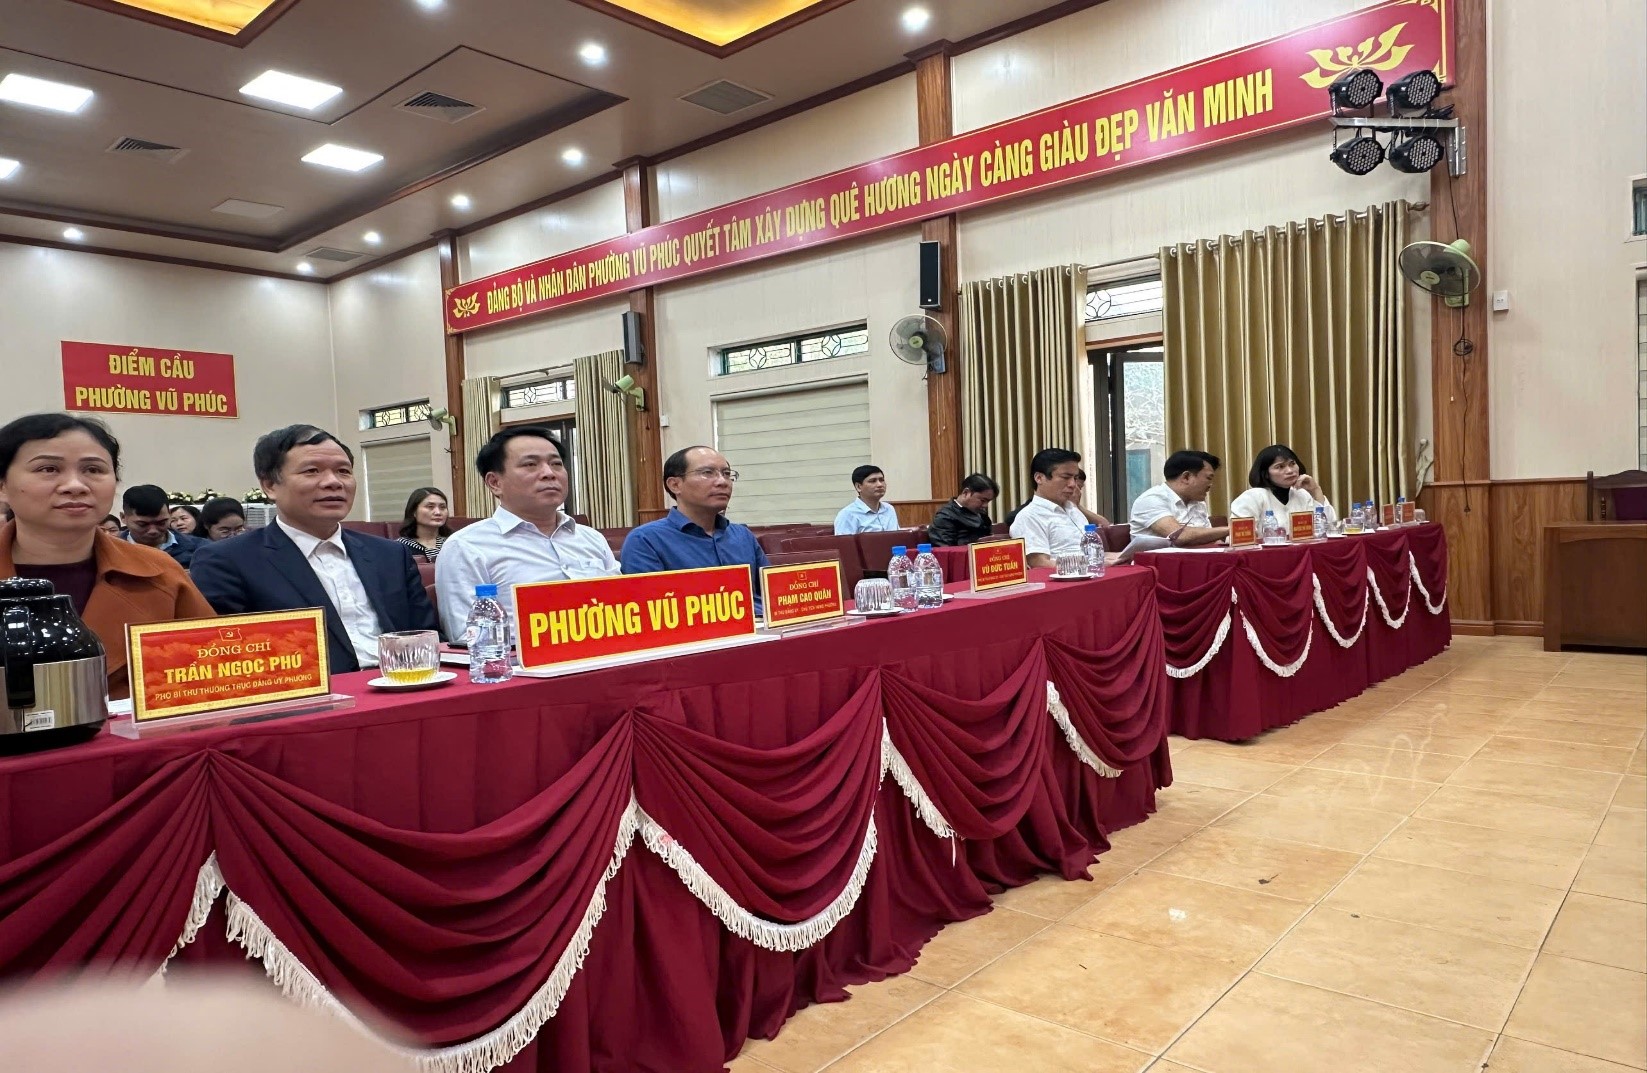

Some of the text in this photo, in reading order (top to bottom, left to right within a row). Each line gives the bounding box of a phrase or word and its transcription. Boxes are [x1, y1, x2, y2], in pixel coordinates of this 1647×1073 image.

[487, 68, 1274, 314] ĐẢNG BỘ VÀ NHÂN DÂN PHƯỜNG VŨ PHÚC QUYẾT TÂM XÂY DỰNG QUÊ HƯƠNG NGÀY CÀNG GIÀU ĐẸP VĂN MINH
[109, 348, 195, 379] ĐIỂM CẦU
[75, 384, 228, 413] PHƯỜNG VŨ PHÚC
[778, 588, 832, 606] PHẠM CAO QUÂN
[789, 580, 819, 591] ĐỒNG CHÍ
[529, 586, 746, 648] PHƯỜNG VŨ PHÚC
[197, 638, 271, 659] ĐỒNG CHÍ
[164, 651, 302, 684] TRẦN NGỌC PHÚ
